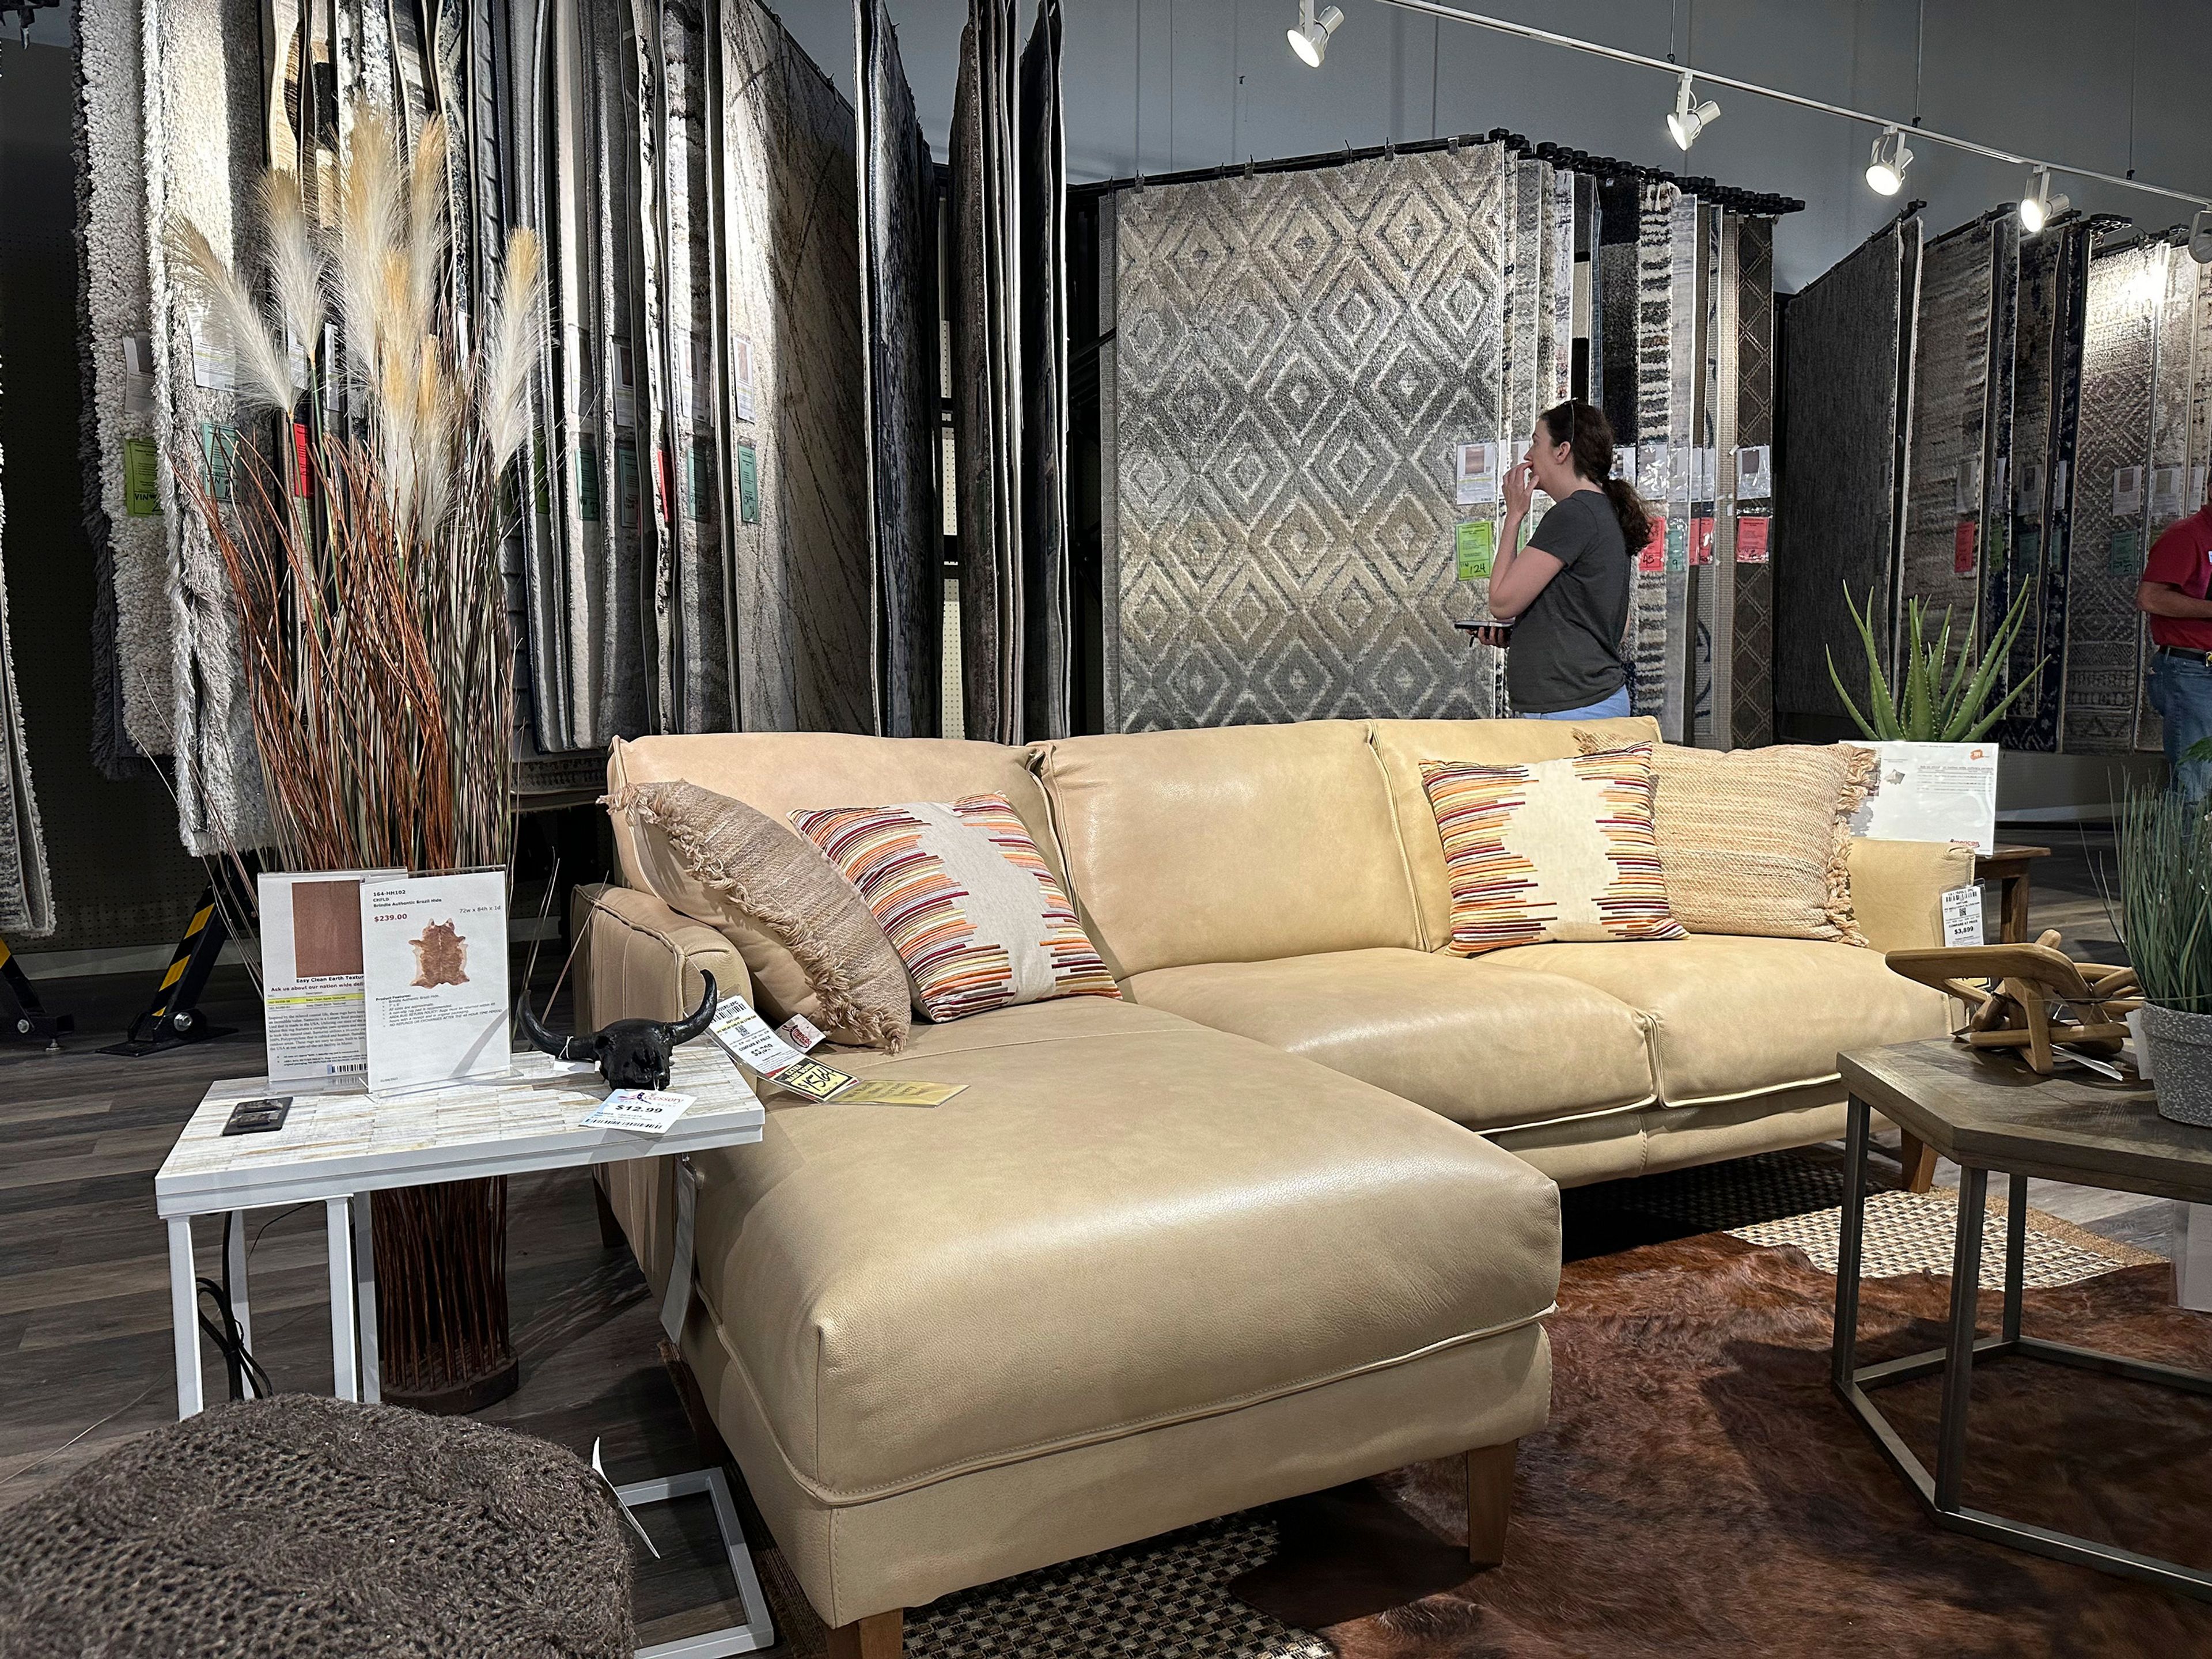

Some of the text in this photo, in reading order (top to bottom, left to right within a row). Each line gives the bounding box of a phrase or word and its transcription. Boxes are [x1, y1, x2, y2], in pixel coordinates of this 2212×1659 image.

[1470, 563, 1486, 574] 124
[374, 913, 407, 922] $239.00
[785, 1065, 803, 1075] EXTRA
[615, 1105, 662, 1113] $12.99
